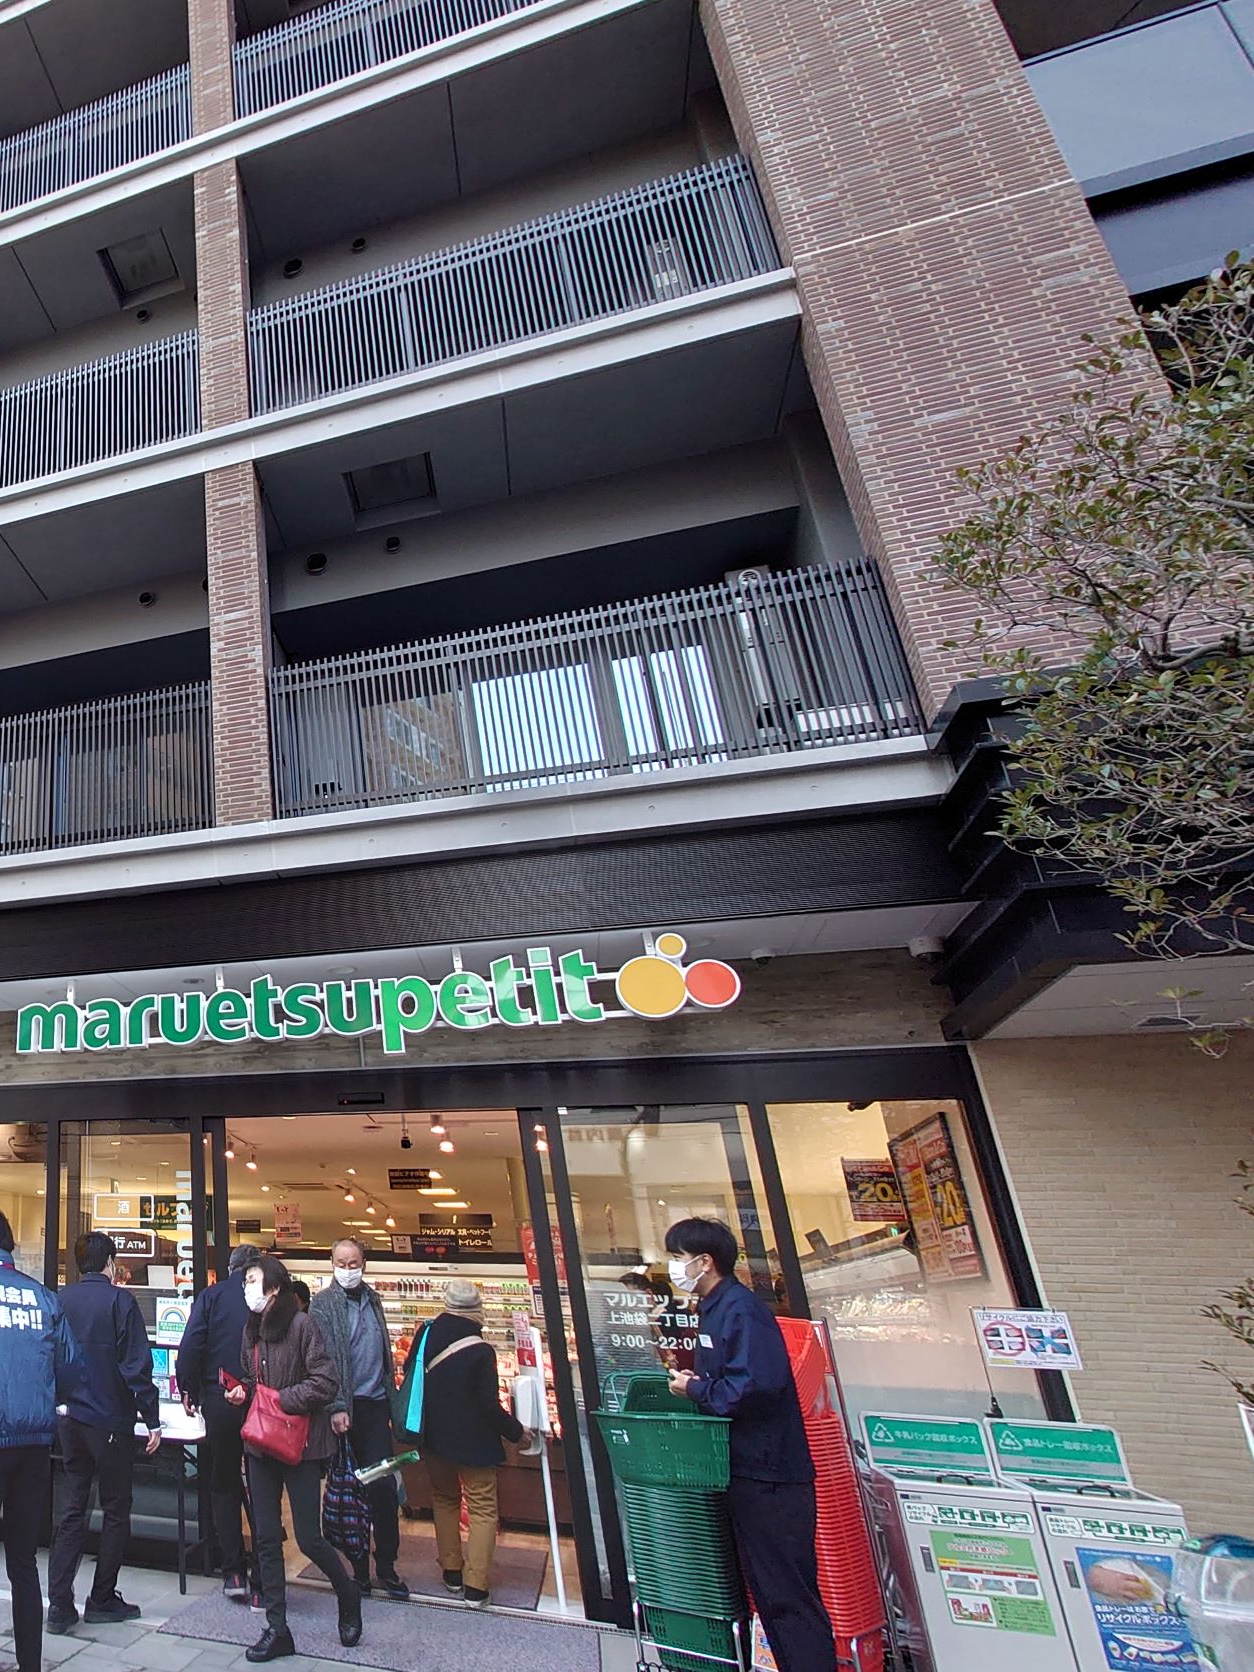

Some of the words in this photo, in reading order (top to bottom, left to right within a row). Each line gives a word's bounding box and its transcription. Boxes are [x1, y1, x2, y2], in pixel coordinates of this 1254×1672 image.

[16, 947, 605, 1054] maruetsupetit
[126, 1241, 146, 1249] ATM
[603, 1293, 669, 1308] マルエツ
